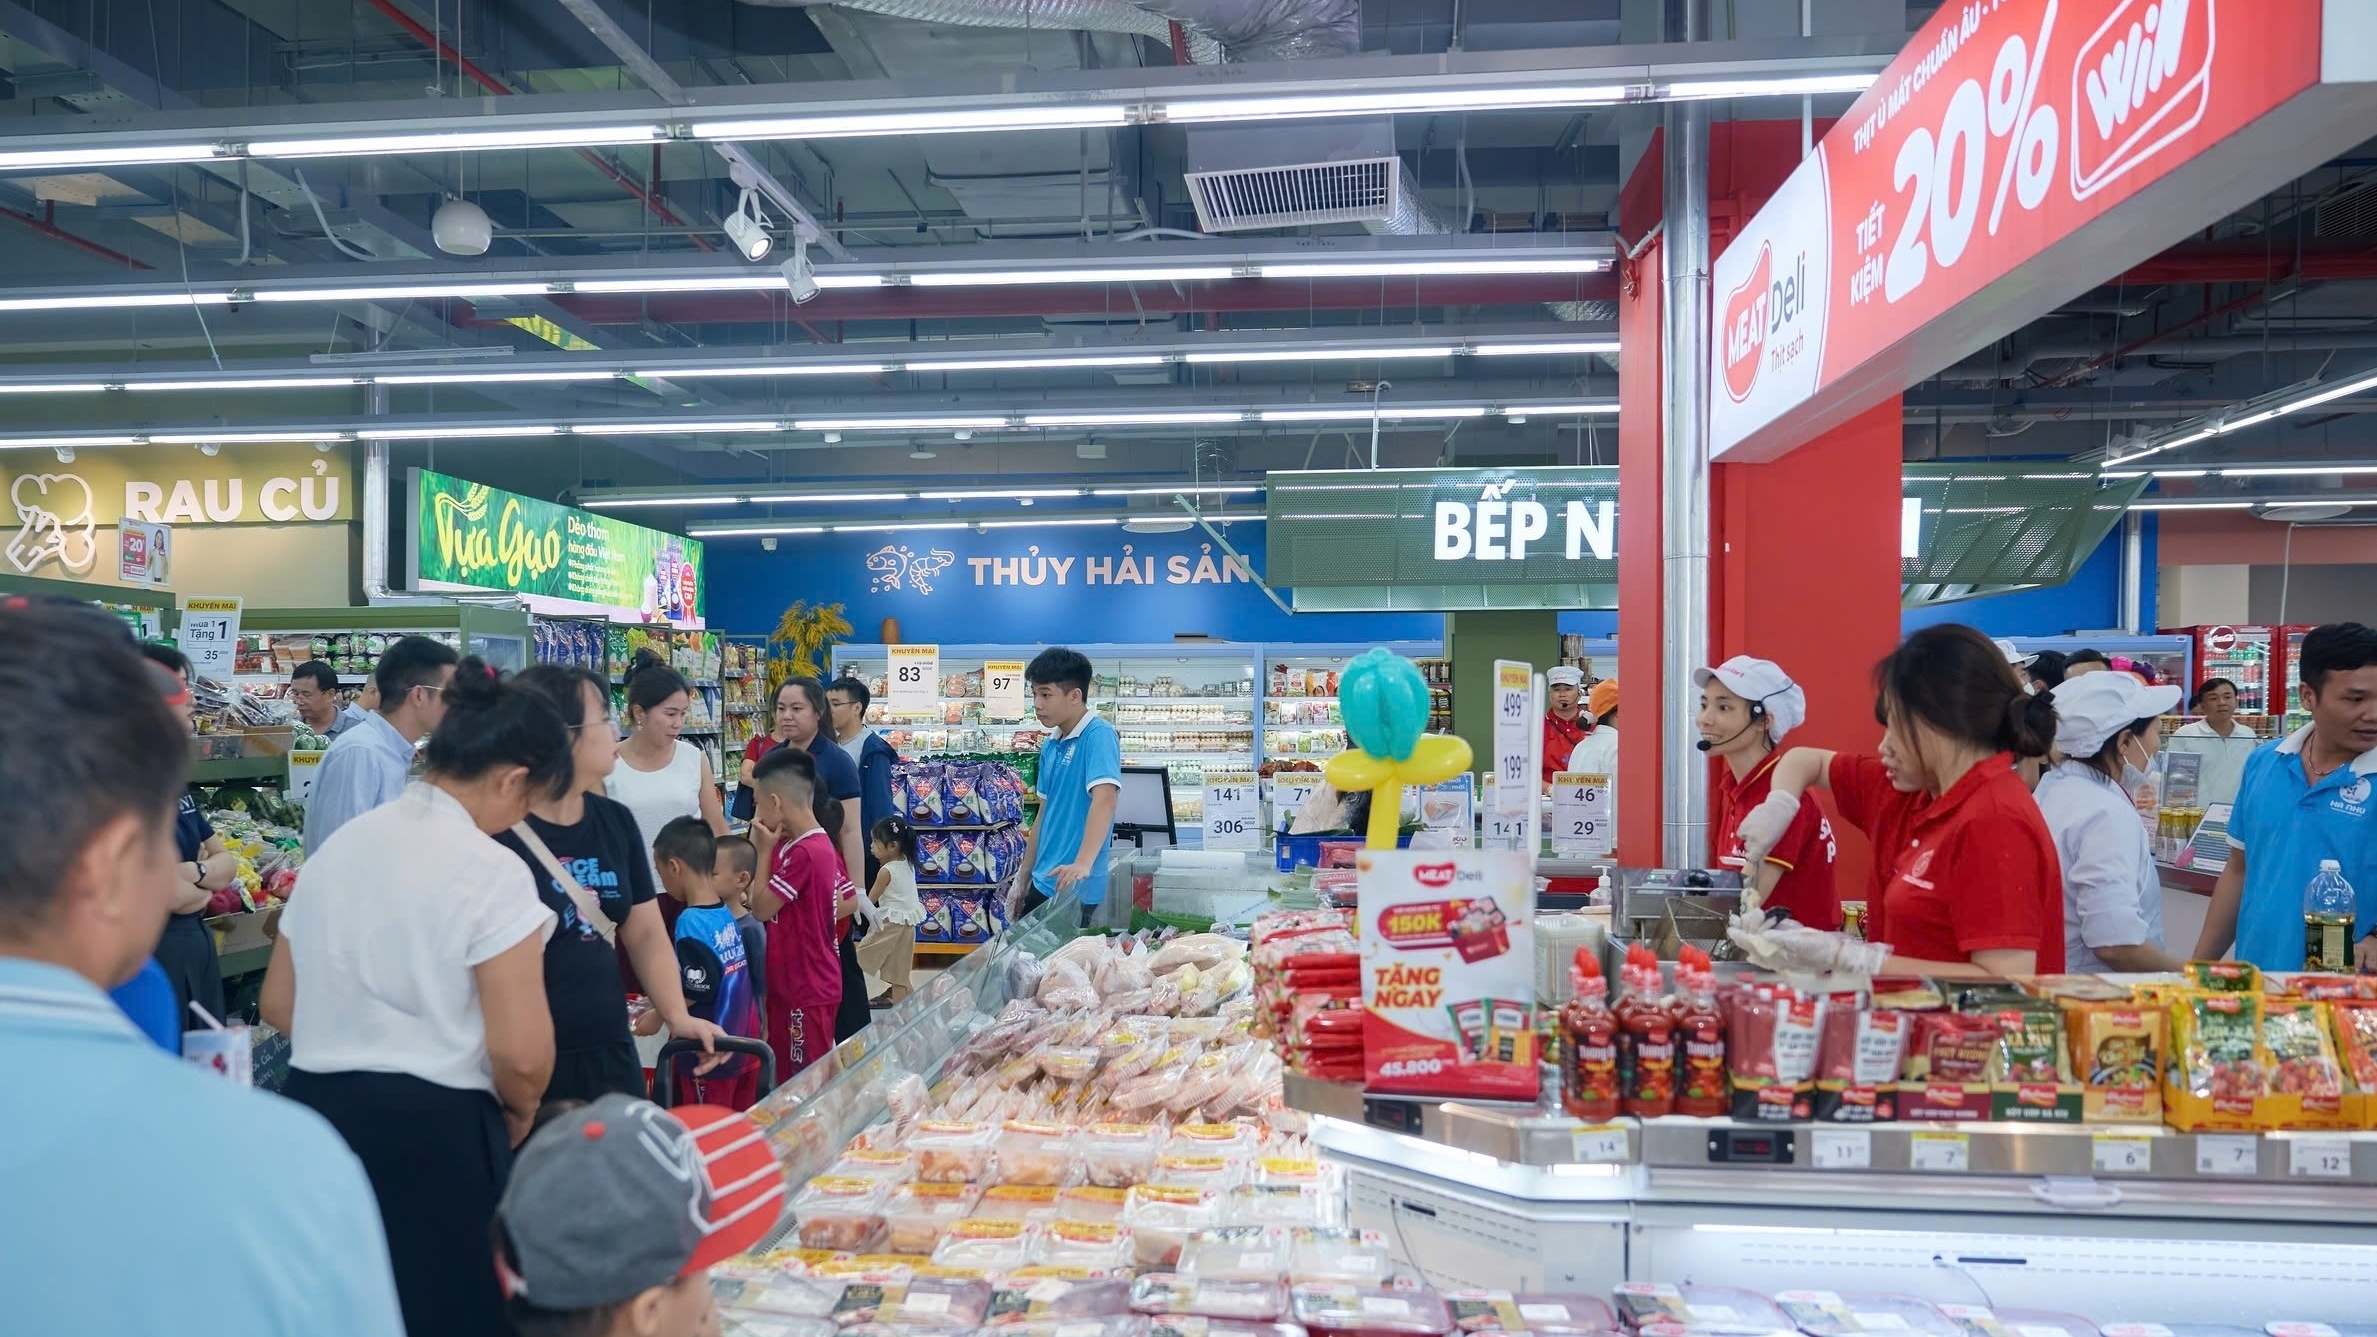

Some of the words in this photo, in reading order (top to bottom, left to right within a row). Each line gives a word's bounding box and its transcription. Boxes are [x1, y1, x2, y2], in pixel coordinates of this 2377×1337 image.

[1885, 0, 2060, 304] 20%
[1856, 199, 1886, 254] TIẾT
[1850, 252, 1884, 307] KIỆM
[1727, 291, 1768, 370] MEAT
[1771, 250, 1806, 335] Deli
[125, 478, 243, 523] RAU
[259, 458, 340, 522] CỦ
[568, 516, 587, 537] Dẻo
[1434, 478, 1548, 560] BẾP
[498, 498, 561, 587] Gạo
[967, 545, 1075, 586] THỦY
[1086, 544, 1154, 585] HẢI
[1167, 543, 1251, 584] SẢN
[190, 628, 215, 640] Tặng
[218, 620, 228, 639] 1
[204, 650, 218, 660] 35
[898, 666, 921, 682] 83
[993, 677, 1011, 690] 97
[1503, 692, 1521, 718] 499
[1503, 755, 1521, 781] 199
[1213, 787, 1240, 801] 141
[1574, 787, 1595, 802] 46
[1213, 820, 1243, 834] 306
[1573, 821, 1594, 835] 29
[1457, 869, 1483, 881] Deli
[1388, 912, 1443, 934] 150K
[1373, 989, 1443, 1009] NGAY
[1379, 1058, 1444, 1078] 45.800
[1600, 1140, 1615, 1152] 14
[2125, 1151, 2136, 1165] 6
[2322, 1156, 2340, 1170] 12
